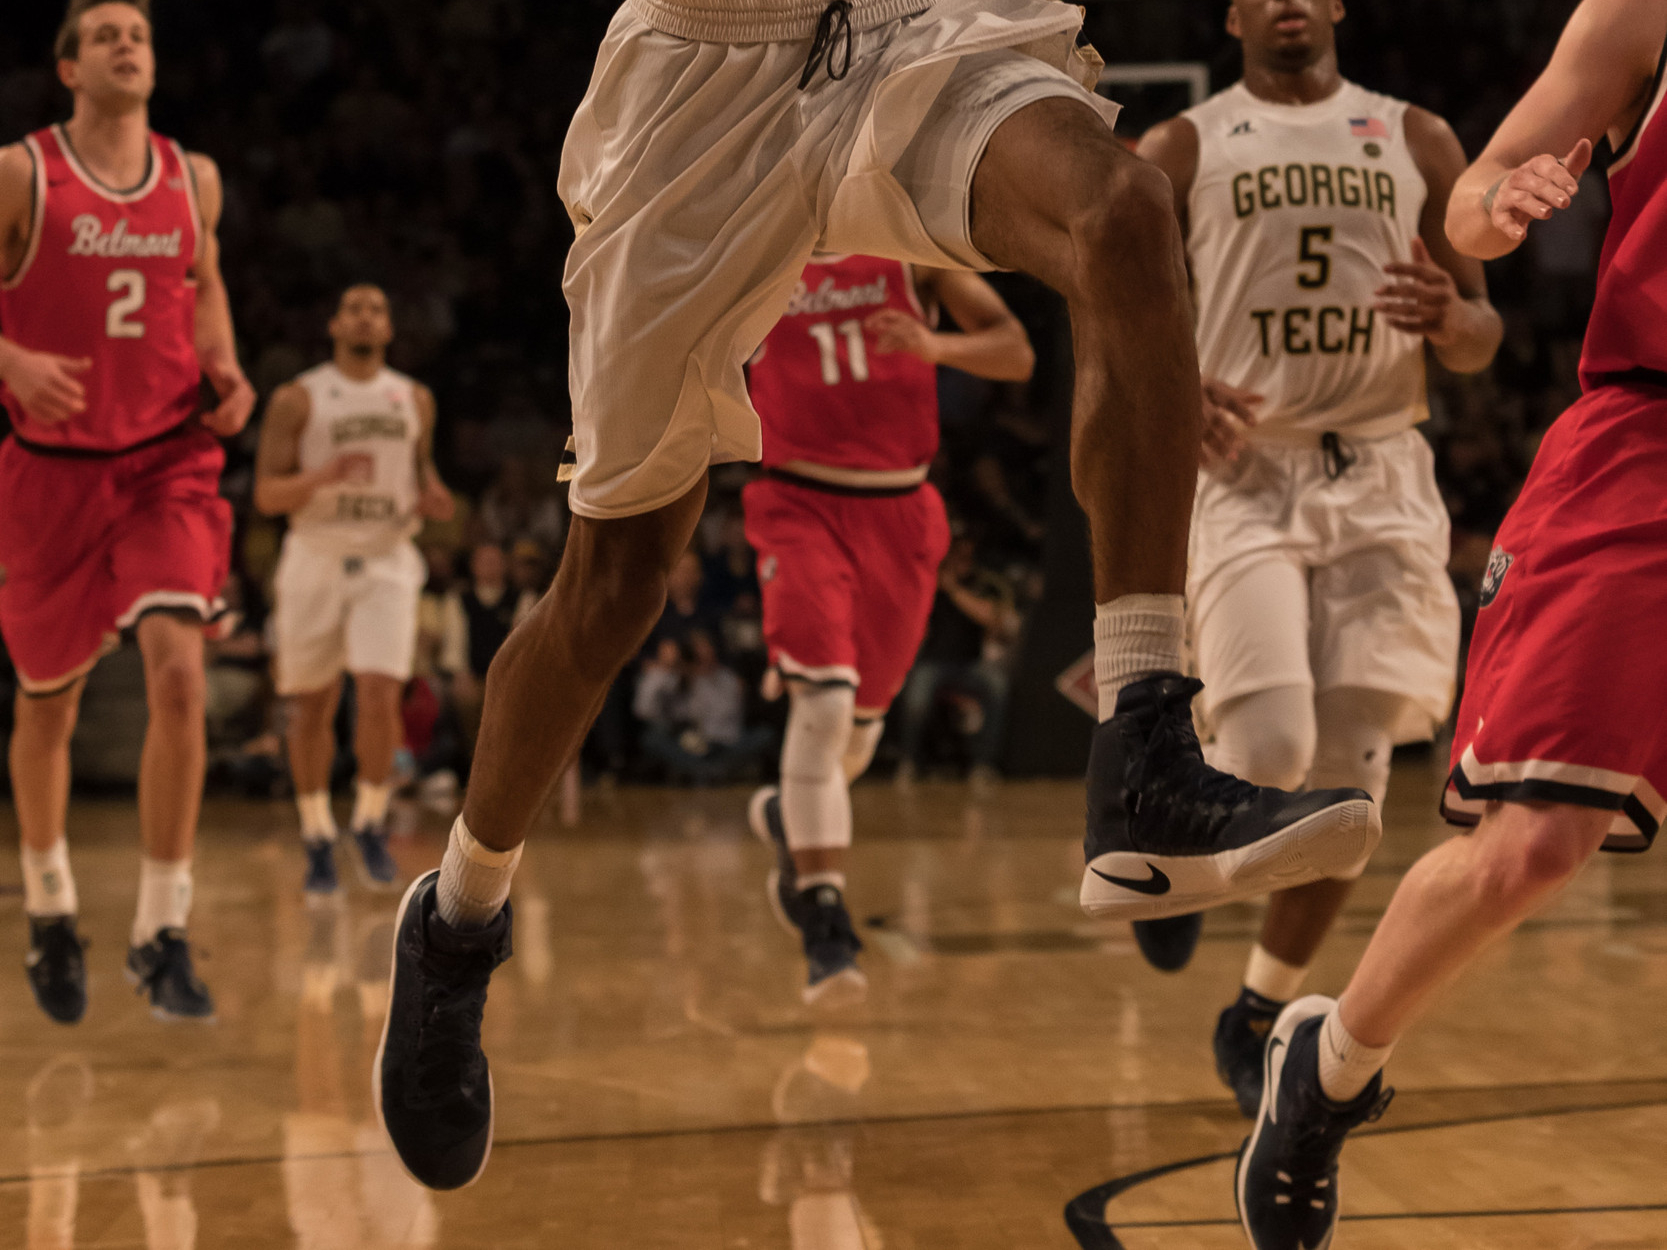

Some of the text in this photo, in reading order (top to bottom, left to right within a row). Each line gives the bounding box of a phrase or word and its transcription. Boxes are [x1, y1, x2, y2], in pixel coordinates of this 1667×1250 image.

[1232, 163, 1397, 220] GEORGIA
[67, 213, 182, 258] Belmont
[1297, 224, 1334, 289] 5
[105, 268, 146, 338] 2
[1250, 306, 1375, 358] TECH
[808, 317, 869, 386] 11
